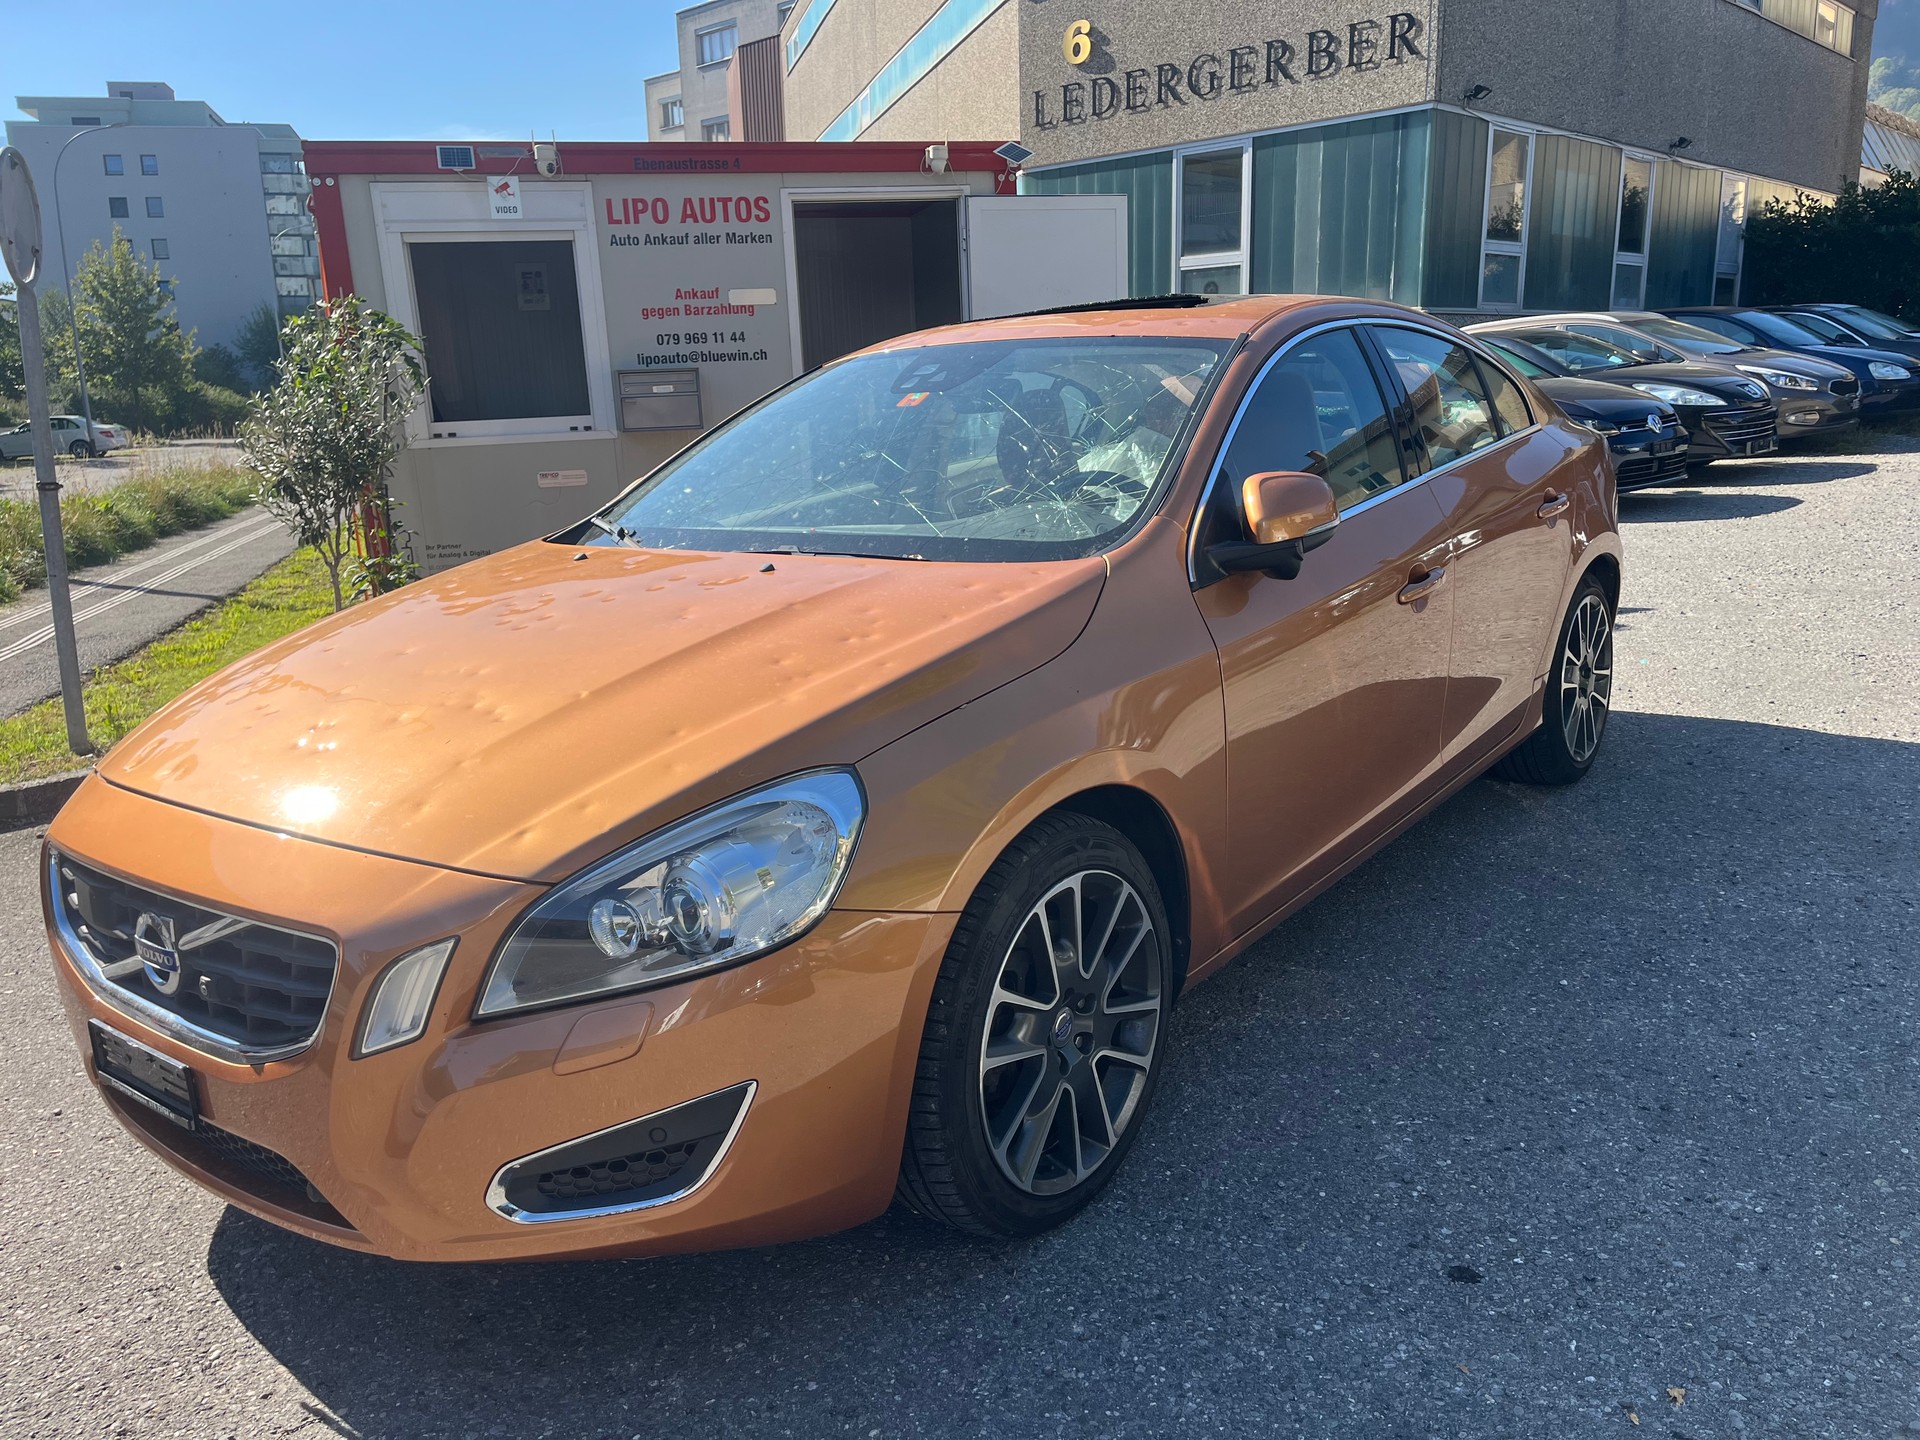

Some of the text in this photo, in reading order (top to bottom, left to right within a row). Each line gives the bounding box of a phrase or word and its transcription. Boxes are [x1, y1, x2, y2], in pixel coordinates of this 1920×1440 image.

[1063, 19, 1093, 66] 6
[1033, 12, 1420, 129] LEDERGERBER
[633, 157, 741, 171] Ebenaustrasse 4
[495, 205, 518, 214] VIDEO
[605, 196, 771, 225] LIPO AUTOS
[610, 232, 773, 247] Auto Ankauf aller Marken
[675, 287, 720, 300] Ankauf
[641, 303, 755, 320] gegen Barzahlung
[656, 331, 746, 346] 079 969 11 44
[637, 348, 768, 367] lipoauto@bluewin.ch
[437, 543, 462, 551] Partner
[438, 551, 462, 559] Analog
[136, 943, 174, 967] VOLVO
[967, 930, 997, 998] SUMMER
